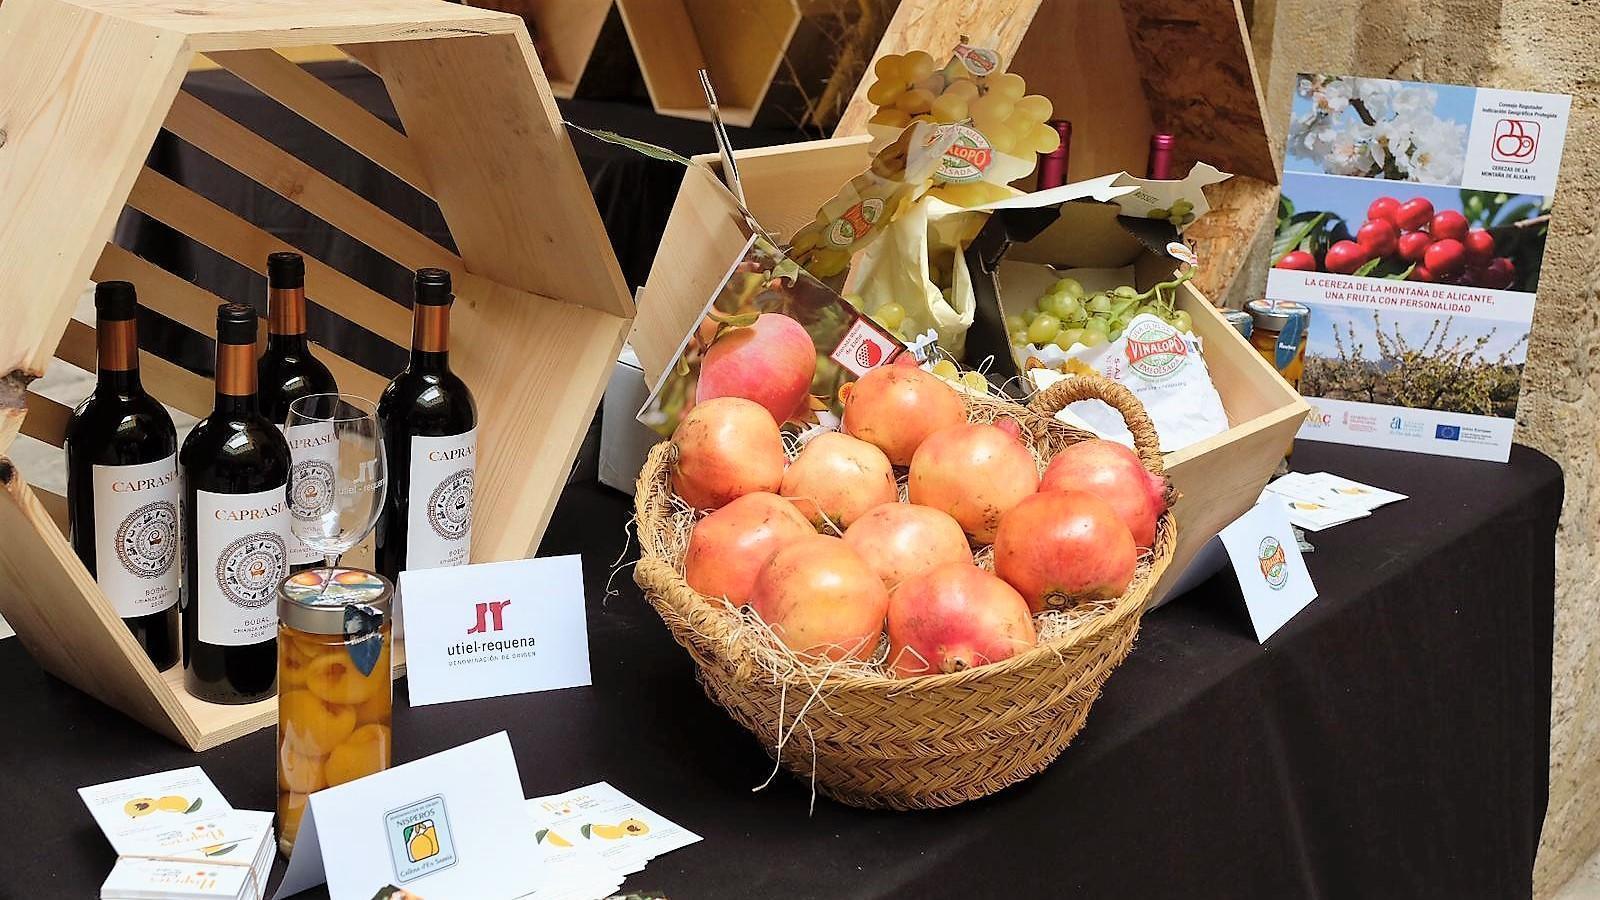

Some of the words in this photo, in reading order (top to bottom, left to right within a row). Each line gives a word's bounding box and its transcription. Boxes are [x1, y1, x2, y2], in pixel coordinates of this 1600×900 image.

[1305, 278, 1316, 286] LA
[1319, 279, 1354, 290] CEREZA
[1356, 282, 1368, 291] DE
[1371, 284, 1382, 293] LA
[1385, 286, 1430, 298] MONTAÑA
[1432, 290, 1445, 299] DE
[1447, 291, 1495, 305] ALICANTE,
[1325, 291, 1344, 300] UNA
[1347, 293, 1376, 304] FRUTA
[1378, 296, 1398, 306] CON
[1399, 298, 1472, 313] PERSONALIDAD
[447, 637, 536, 656] utiel-requena
